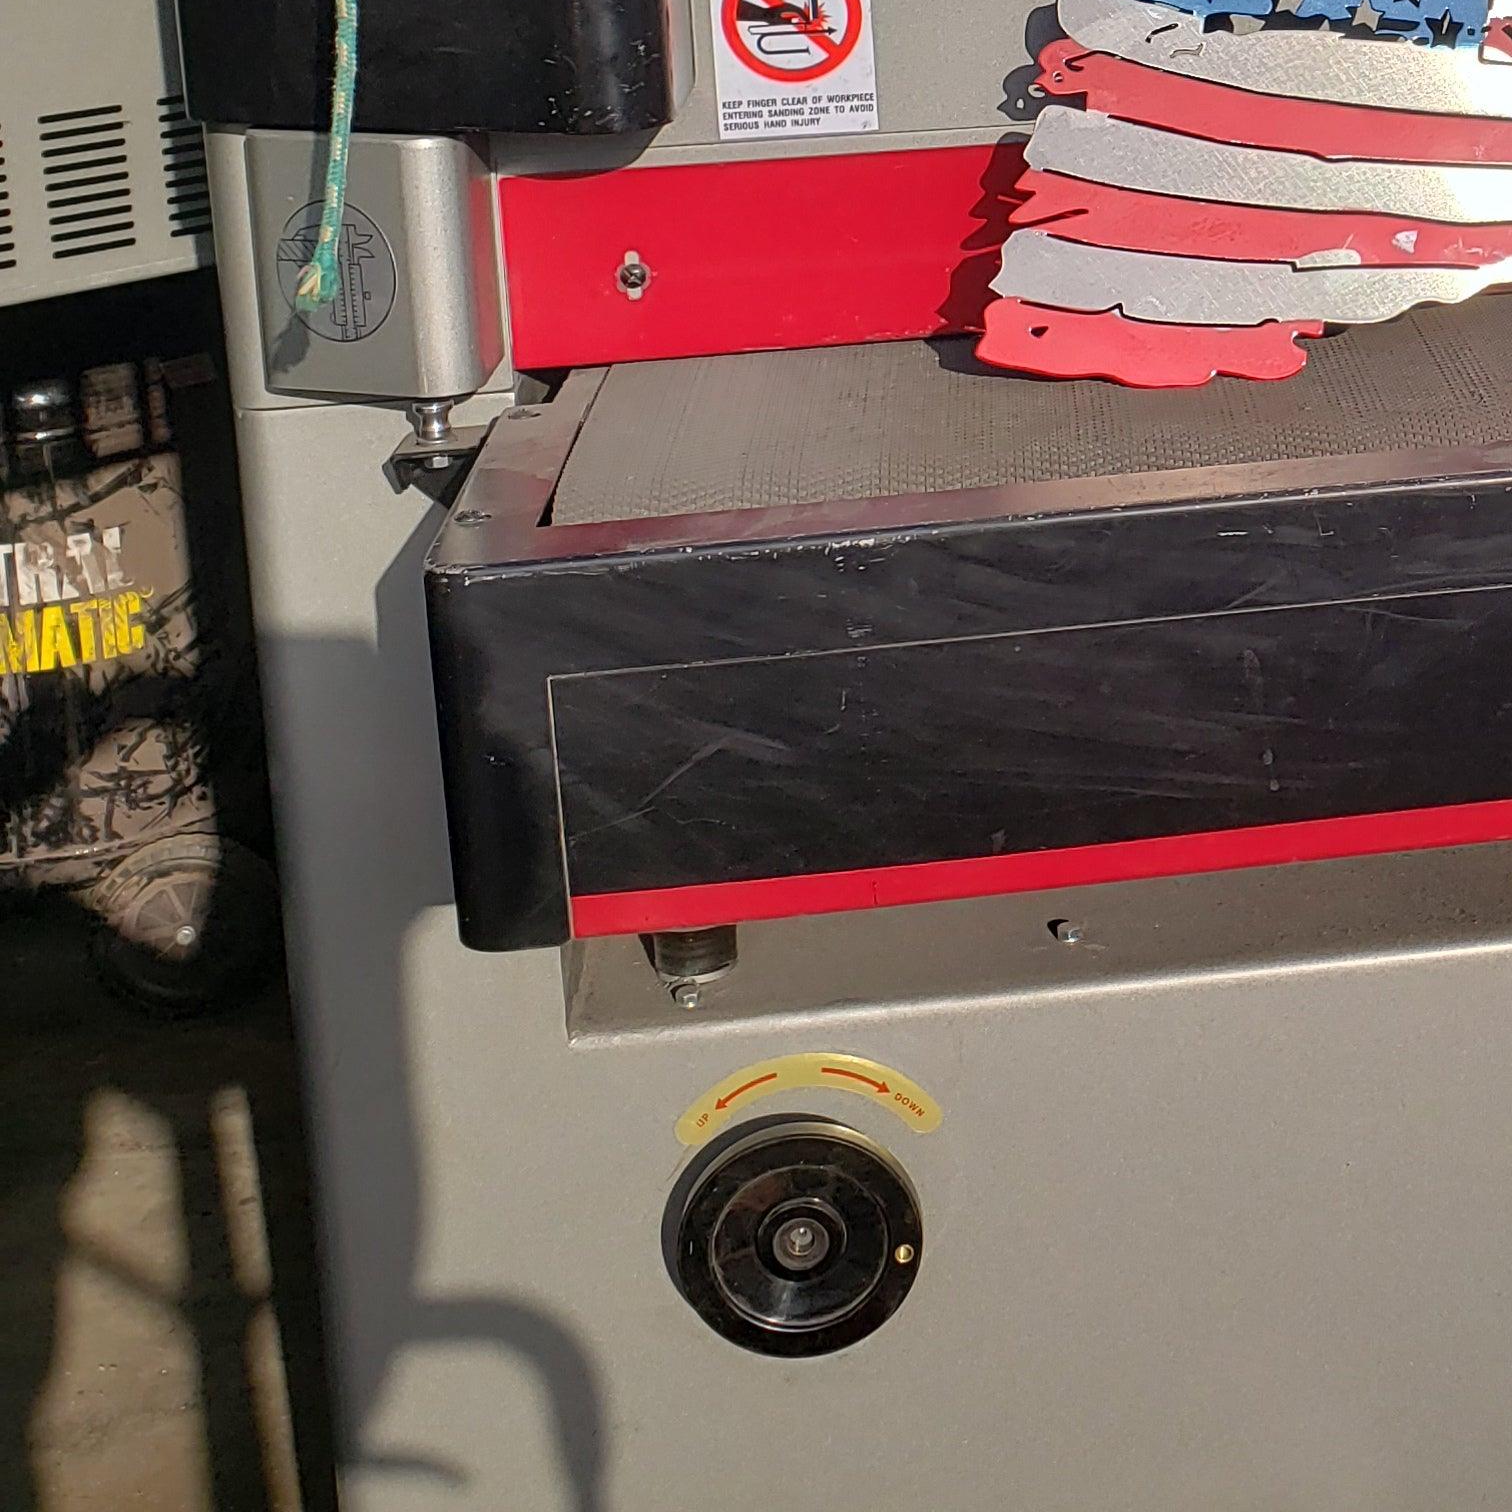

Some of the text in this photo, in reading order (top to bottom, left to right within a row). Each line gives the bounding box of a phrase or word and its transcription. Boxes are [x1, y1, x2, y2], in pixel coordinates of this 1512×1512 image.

[722, 93, 874, 109] KEEP FINGER CLEAR OF WORKPIECE
[723, 104, 874, 120] ENTERING SANDING ZONE TO AVOID
[724, 117, 821, 131] SERIOUS HAND INJURY
[894, 1092, 926, 1117] DOWN
[696, 1112, 710, 1128] UP
